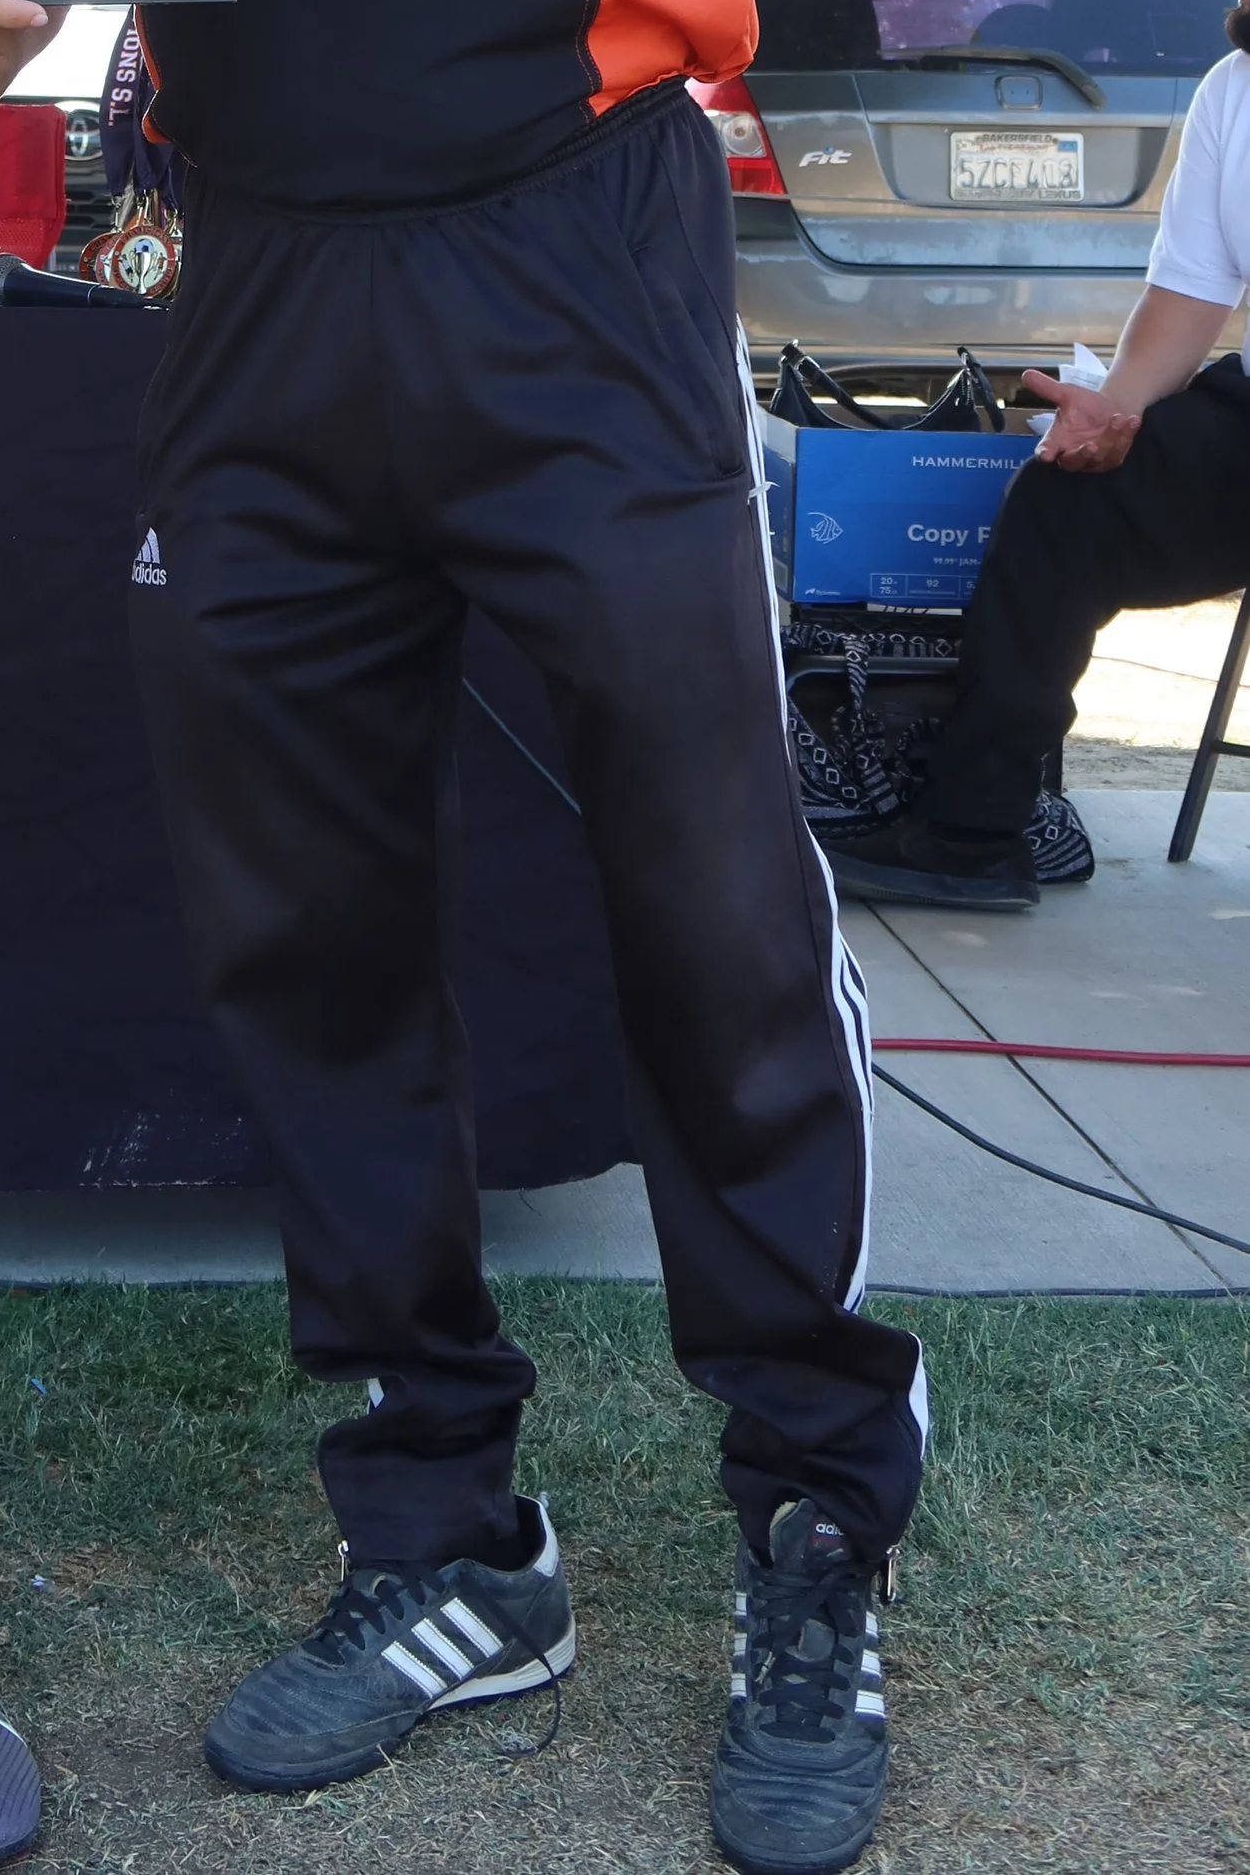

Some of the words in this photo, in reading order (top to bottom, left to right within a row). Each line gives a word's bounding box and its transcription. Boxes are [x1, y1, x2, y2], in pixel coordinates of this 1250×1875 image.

[982, 133, 1053, 143] BAKERSFIELD
[798, 146, 853, 167] Fit
[912, 456, 1024, 470] HAMMERMIL
[907, 524, 969, 547] Copy
